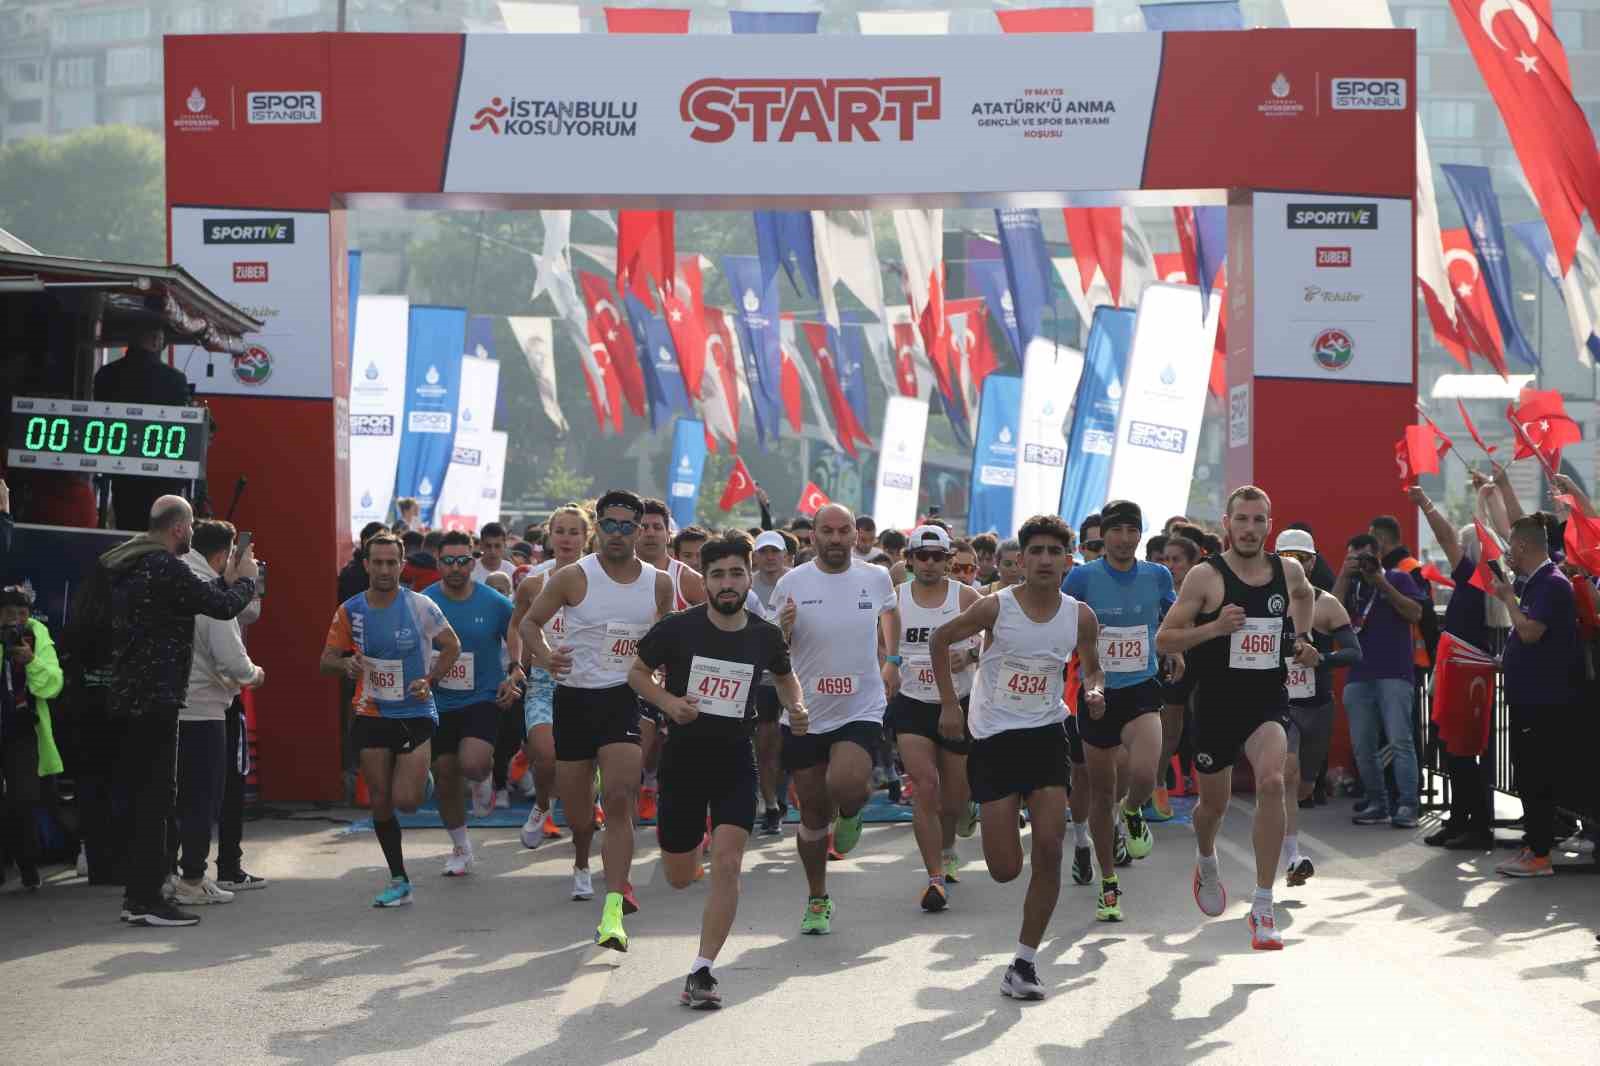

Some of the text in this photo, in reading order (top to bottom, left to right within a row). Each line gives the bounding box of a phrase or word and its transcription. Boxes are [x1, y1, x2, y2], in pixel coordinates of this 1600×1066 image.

[1336, 81, 1400, 96] SPOR
[252, 95, 315, 110] SPOR
[510, 97, 637, 119] İSTANBULU
[681, 77, 940, 143] START
[972, 98, 1116, 115] ATATÜRK'Ü ANMA
[1022, 118, 1034, 126] VE
[1036, 118, 1062, 126] SPOR
[1065, 118, 1110, 126] BAYRAMI
[906, 627, 936, 643] BE
[1241, 633, 1276, 654] 4660
[1107, 640, 1142, 658] 4123
[699, 676, 742, 699] 4757
[817, 677, 852, 694] 4699
[1008, 673, 1048, 694] 4334
